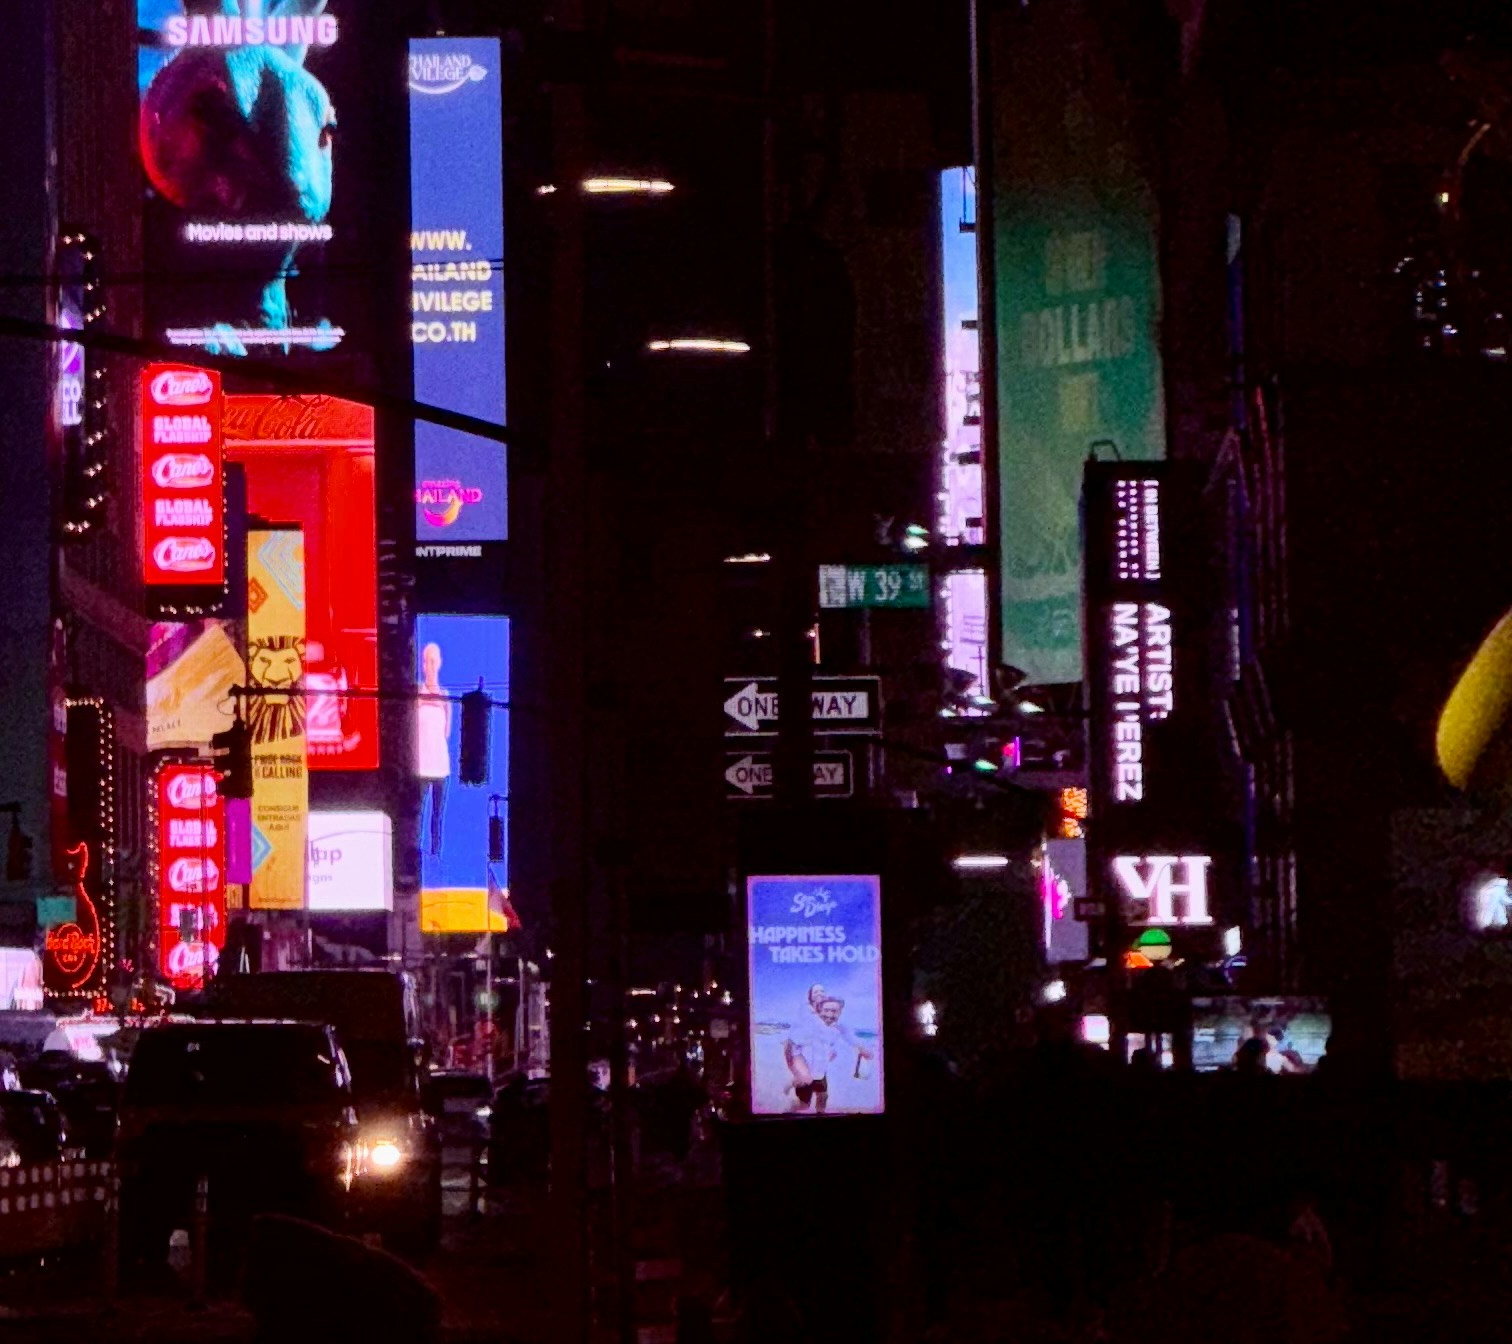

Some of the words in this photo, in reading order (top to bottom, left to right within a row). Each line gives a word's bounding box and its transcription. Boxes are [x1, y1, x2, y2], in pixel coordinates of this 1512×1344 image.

[166, 15, 338, 46] SAMSUNG
[187, 221, 243, 242] Movies
[244, 221, 278, 242] and
[279, 222, 333, 242] shows
[154, 415, 210, 431] GLOBAL
[155, 498, 211, 514] GLOBAL
[848, 569, 865, 601] W
[875, 571, 901, 602] 39
[1143, 602, 1174, 720] ARTIST:
[738, 695, 779, 718] ONE
[735, 766, 773, 787] ONE
[814, 766, 838, 786] AY
[748, 925, 846, 944] HAPPINESS
[769, 945, 825, 963] TAKES
[828, 945, 879, 963] HOLD
